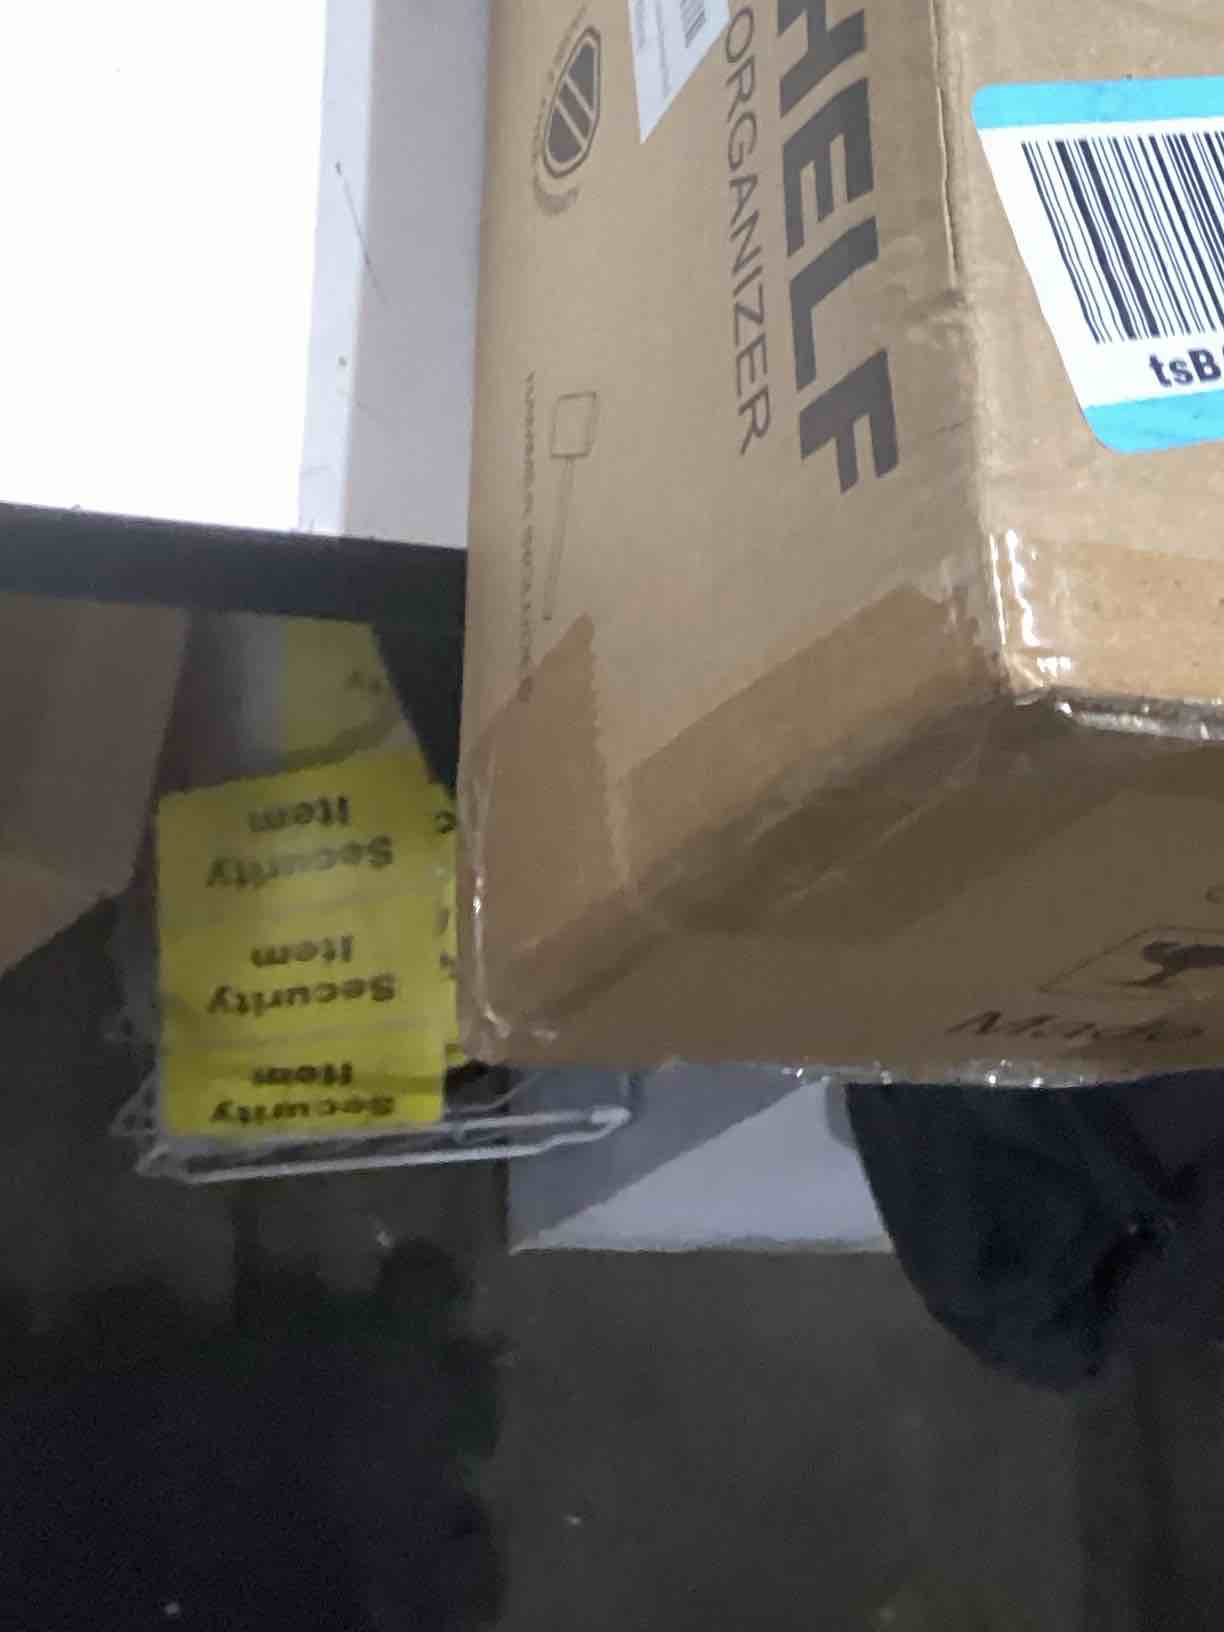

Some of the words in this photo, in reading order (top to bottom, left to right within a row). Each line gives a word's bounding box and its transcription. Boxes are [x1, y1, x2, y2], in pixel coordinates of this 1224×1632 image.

[724, 6, 772, 458] ORGANIZER
[248, 795, 349, 834] Item
[205, 834, 394, 889] Security
[251, 934, 354, 968] Item
[206, 972, 396, 1018] Security
[251, 1062, 354, 1087] Item
[208, 1096, 396, 1126] Security
